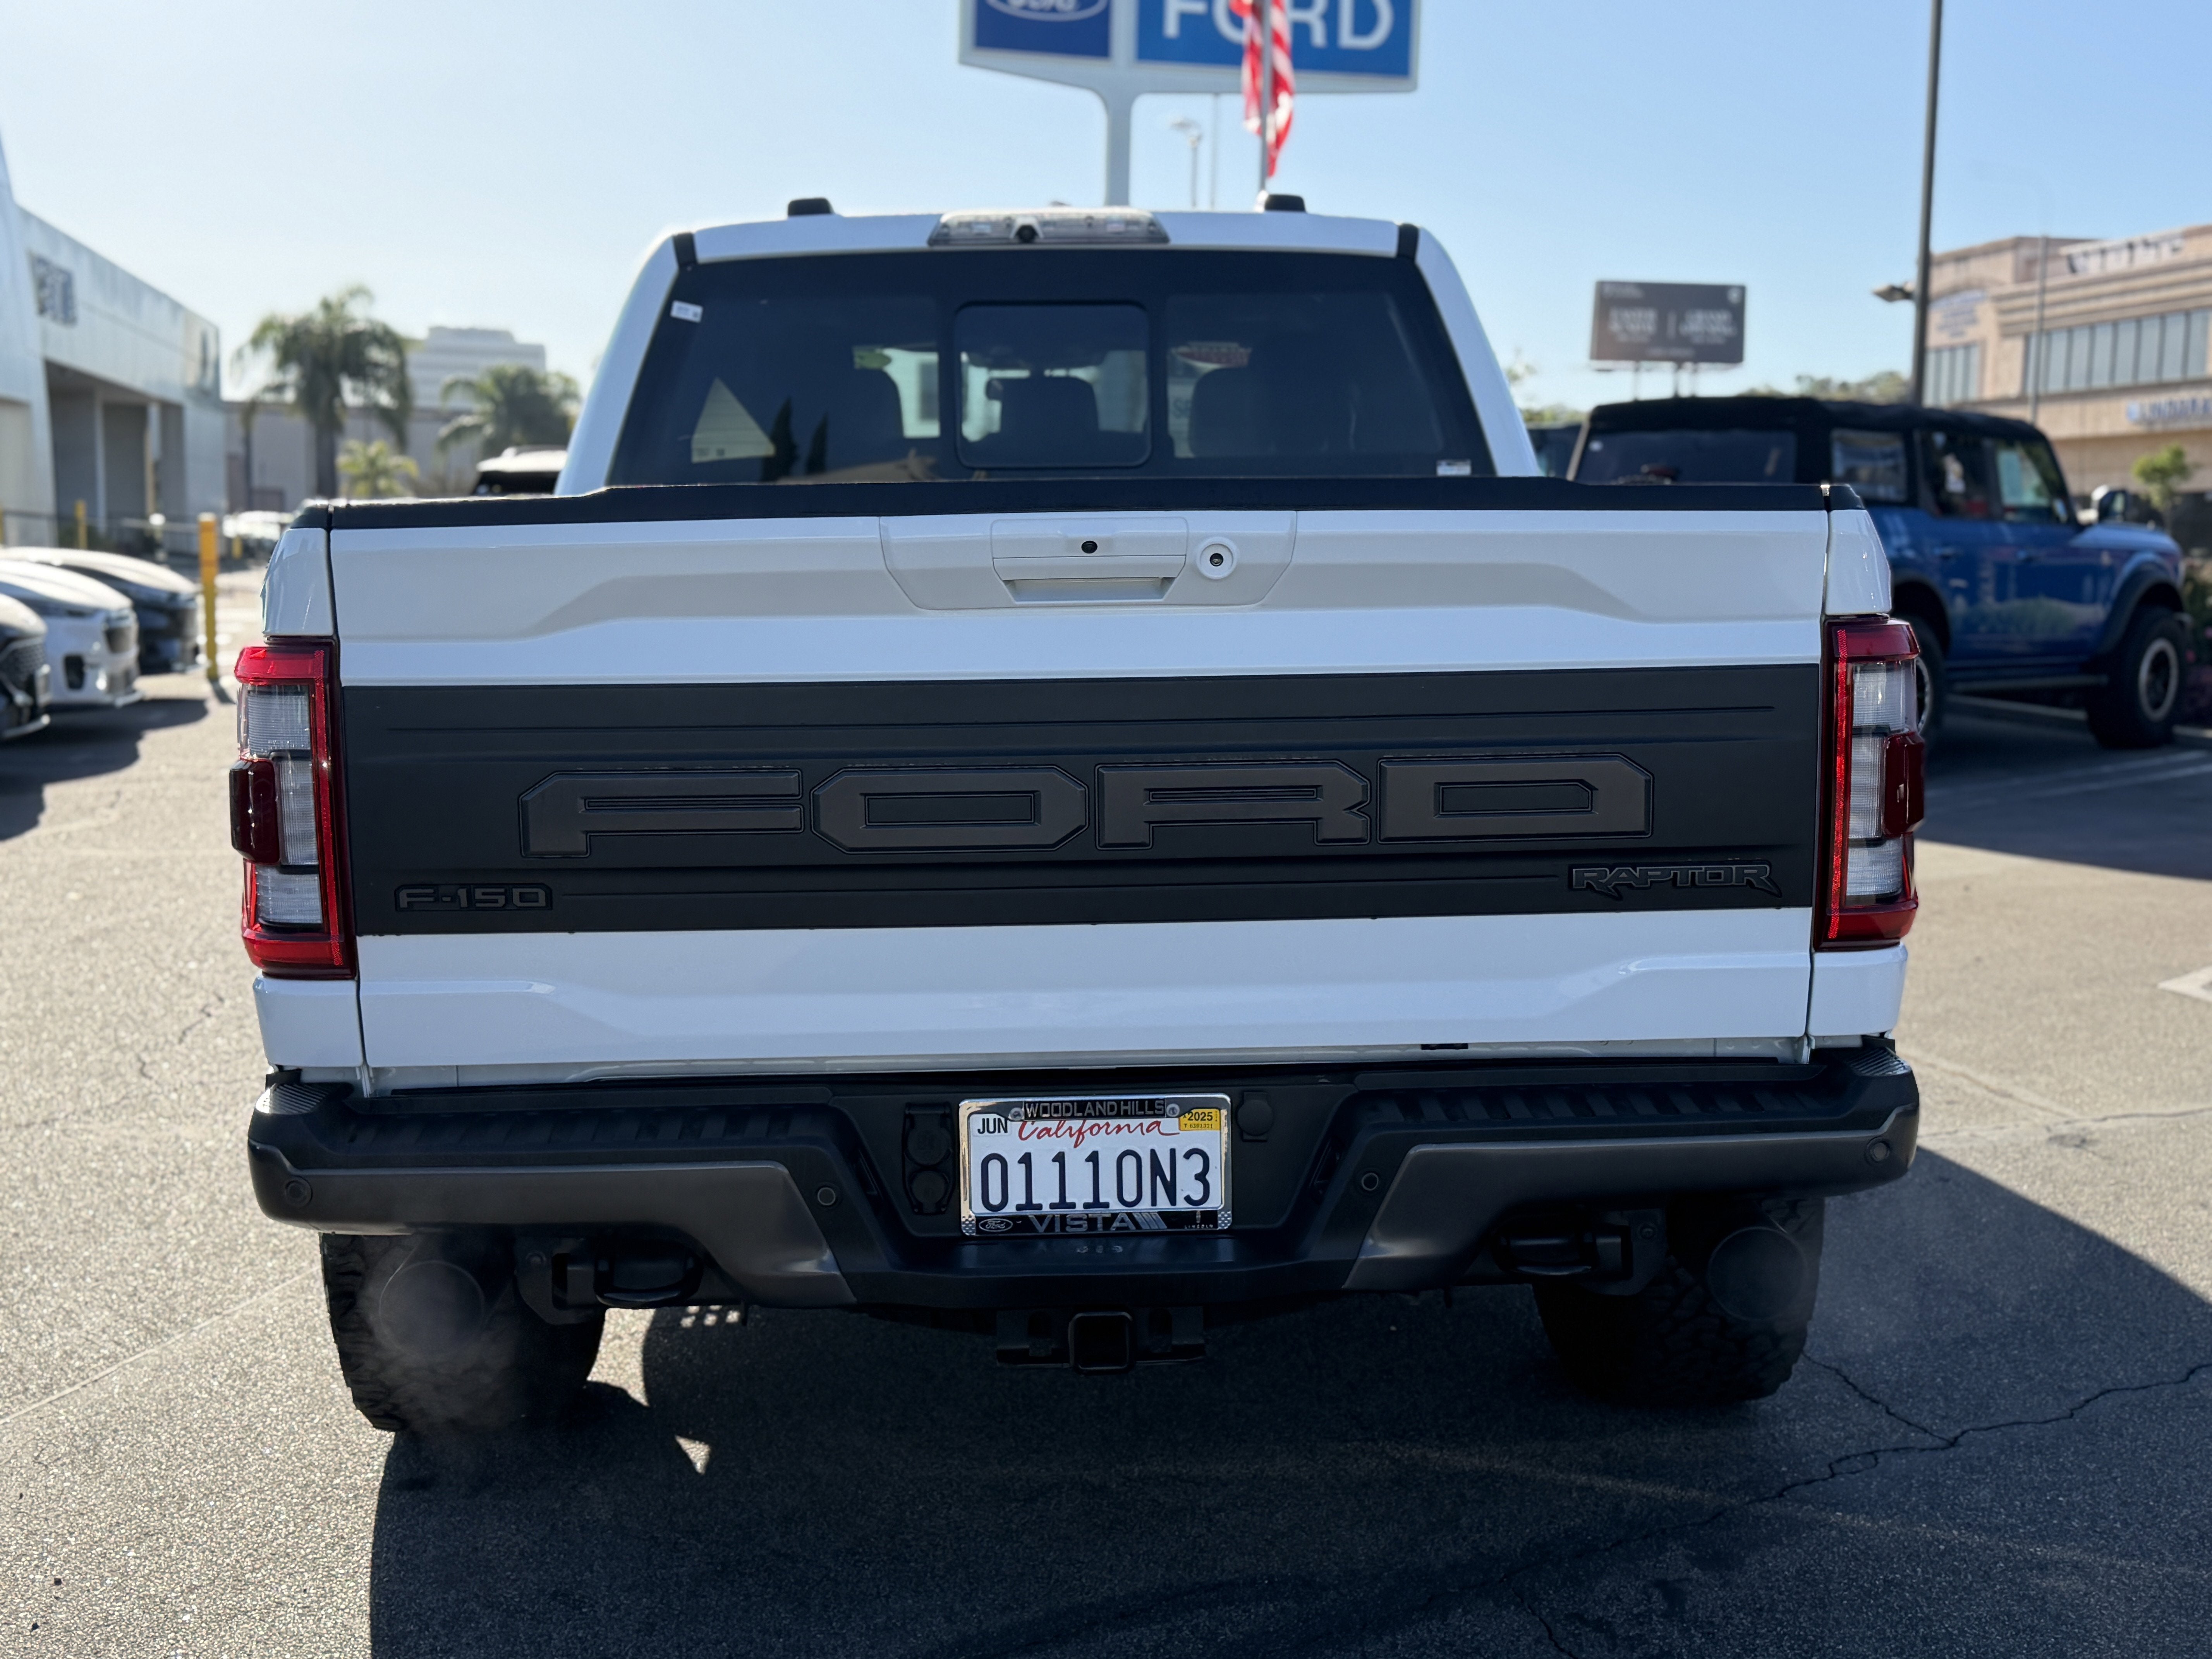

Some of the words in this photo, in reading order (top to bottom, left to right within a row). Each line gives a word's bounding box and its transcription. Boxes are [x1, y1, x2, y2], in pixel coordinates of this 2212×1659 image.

[519, 753, 1653, 857] FORD
[1572, 864, 1781, 899] RAPTOR
[399, 888, 548, 908] F-150
[1026, 1101, 1117, 1118] WOODLAND
[1120, 1100, 1164, 1116] HILLS
[1187, 1111, 1213, 1121] 2025
[977, 1118, 1008, 1134] JUN
[1018, 1120, 1180, 1148] California
[981, 1148, 1210, 1212] 01110N3
[1029, 1213, 1136, 1233] VISTA
